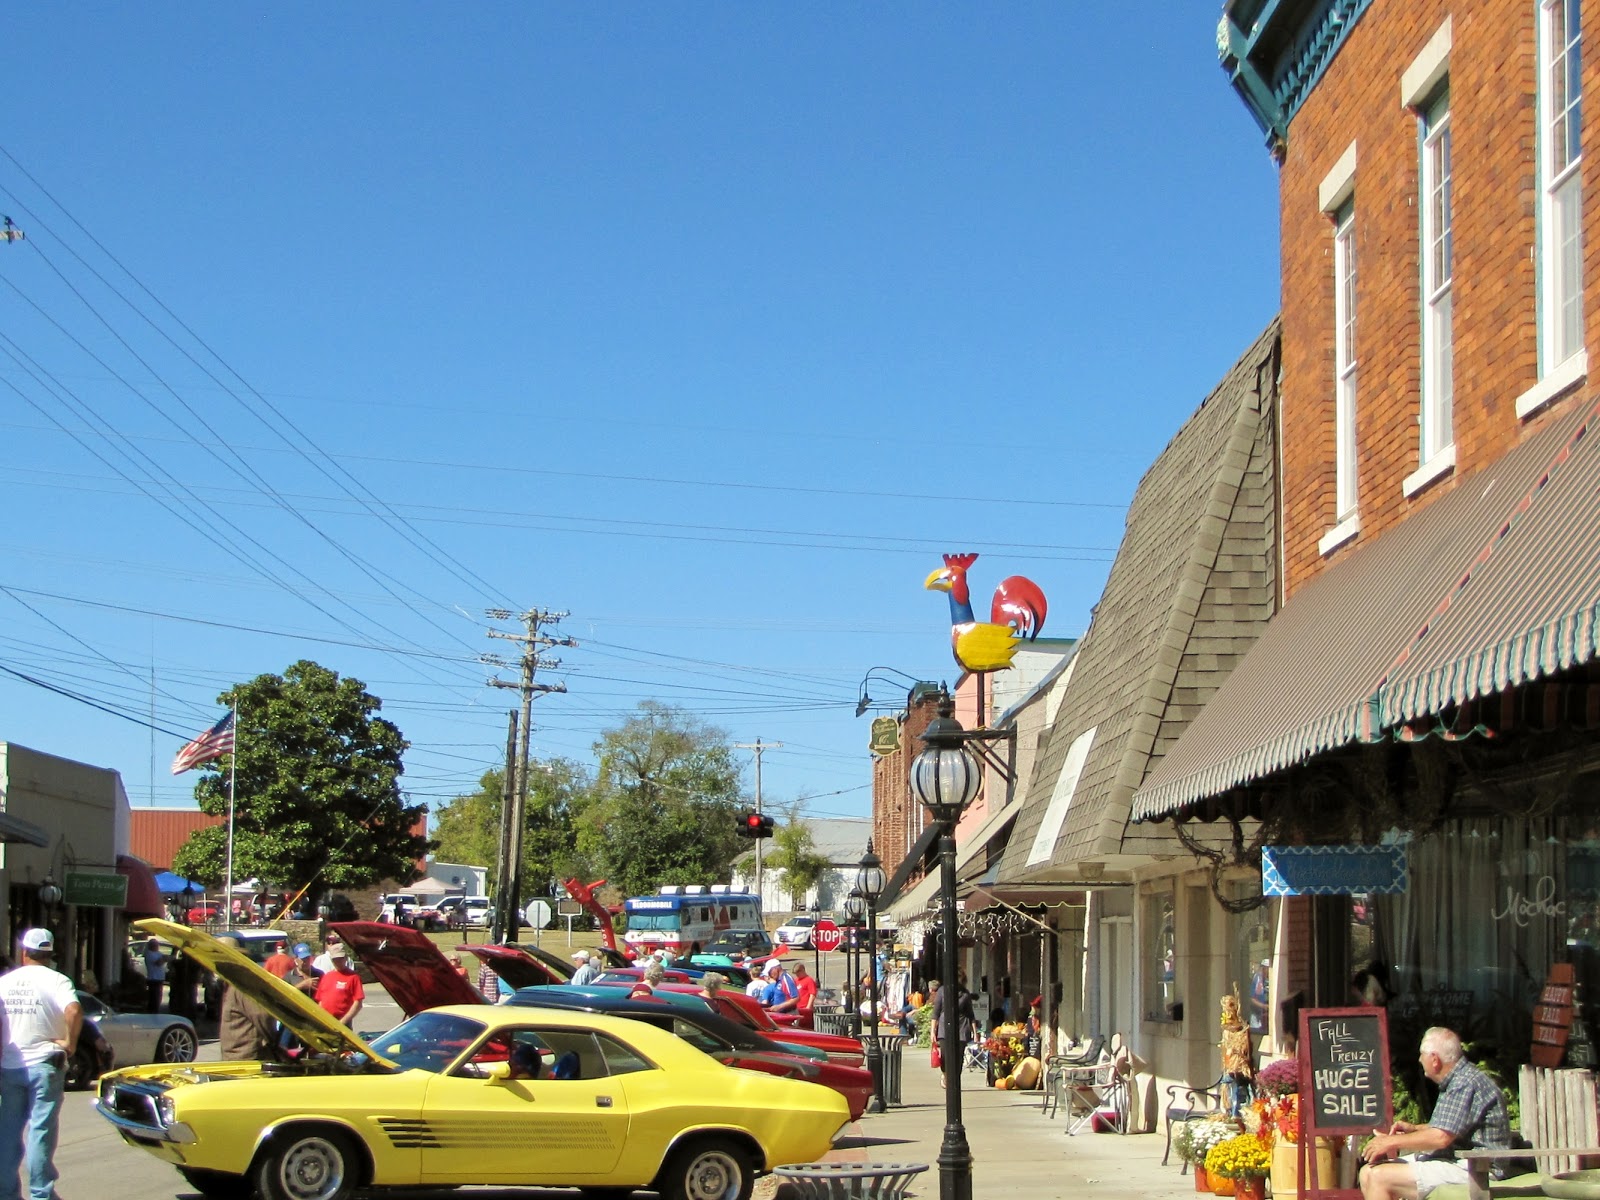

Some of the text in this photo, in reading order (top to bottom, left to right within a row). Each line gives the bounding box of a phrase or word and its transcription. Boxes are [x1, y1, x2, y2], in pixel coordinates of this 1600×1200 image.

[1318, 1020, 1351, 1044] FALL
[1330, 1044, 1375, 1063] FRENZY
[1314, 1068, 1370, 1090] HUGE
[1323, 1093, 1377, 1117] SALE
